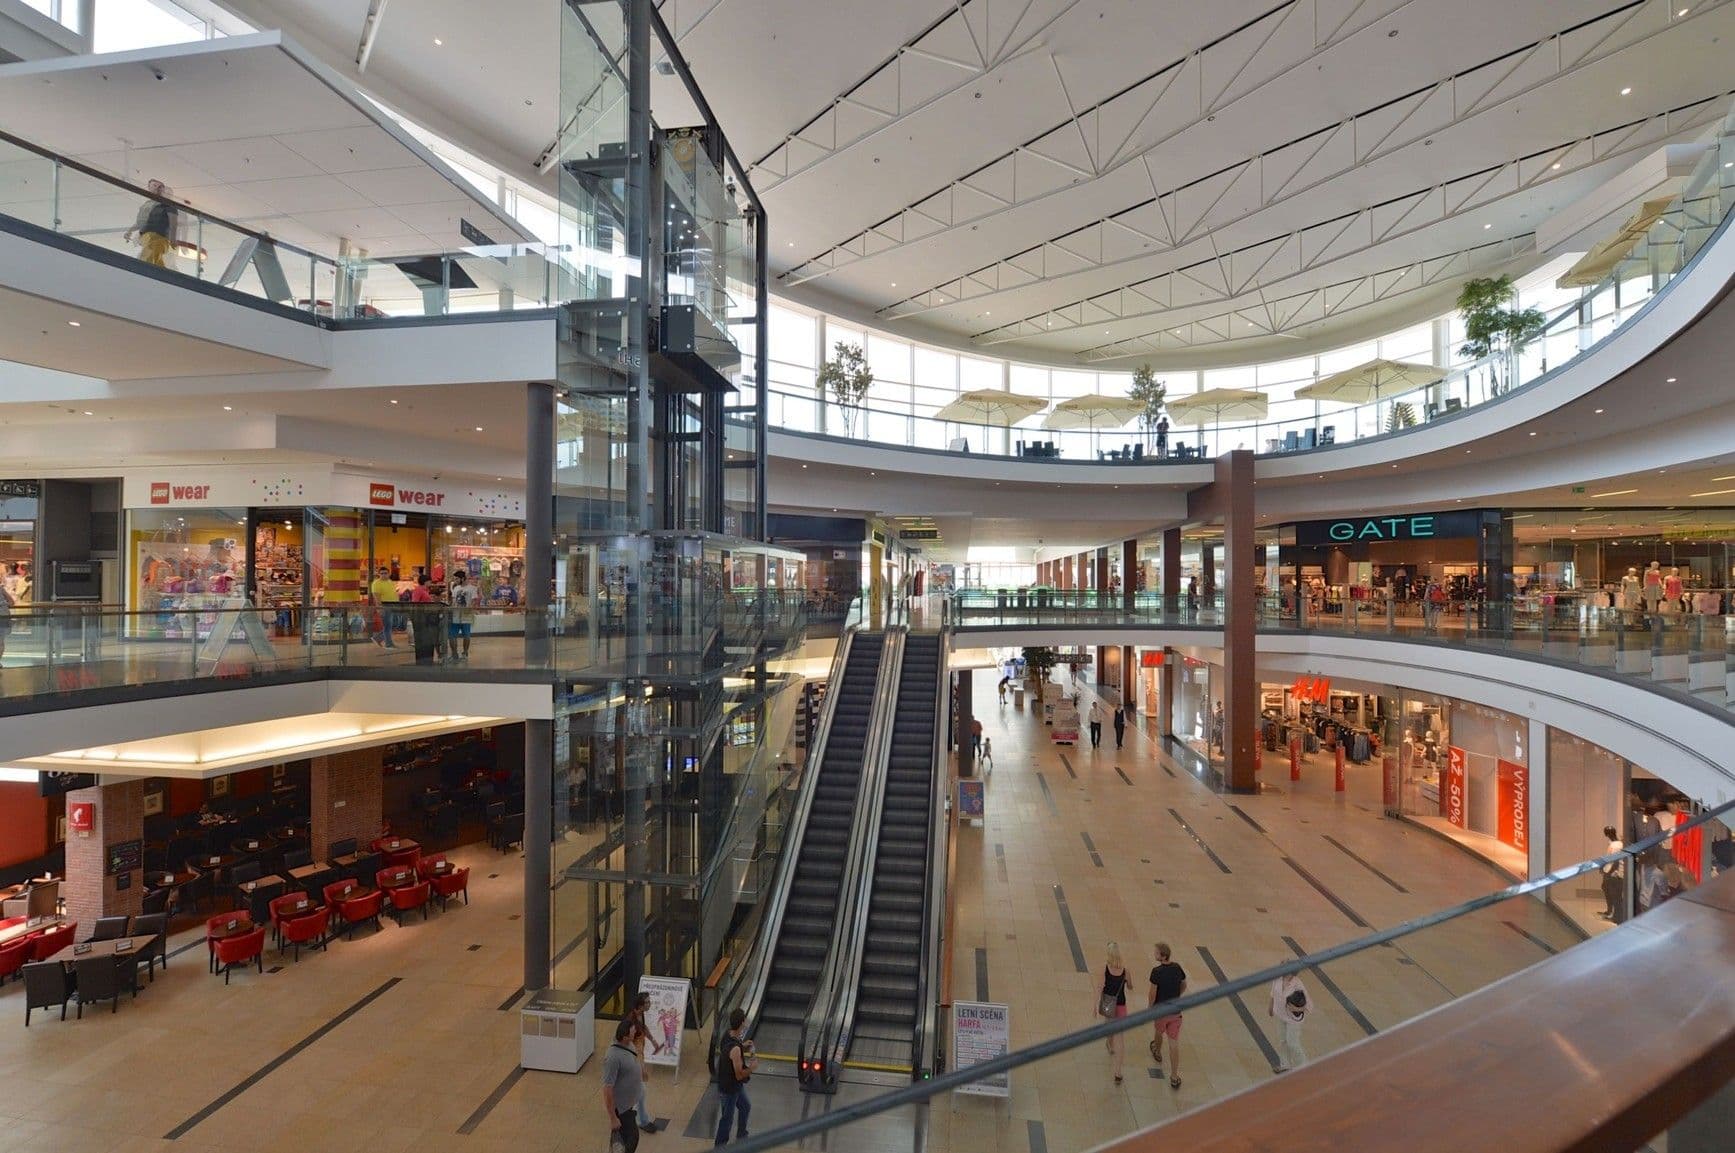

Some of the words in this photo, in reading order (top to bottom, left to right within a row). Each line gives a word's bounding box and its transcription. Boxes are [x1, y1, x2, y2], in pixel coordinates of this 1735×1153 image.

[172, 485, 210, 500] wear
[372, 489, 393, 499] LEGO
[398, 489, 445, 506] wear
[1329, 516, 1434, 540] GATE
[1292, 676, 1330, 704] H&M
[1450, 750, 1462, 776] AŽ
[1450, 780, 1461, 824] -50%
[1513, 769, 1526, 848] VÝPRODEJ
[958, 1008, 978, 1018] LETNÍ
[980, 1009, 1004, 1021] SCÉNA
[958, 1019, 981, 1029] HARFA
